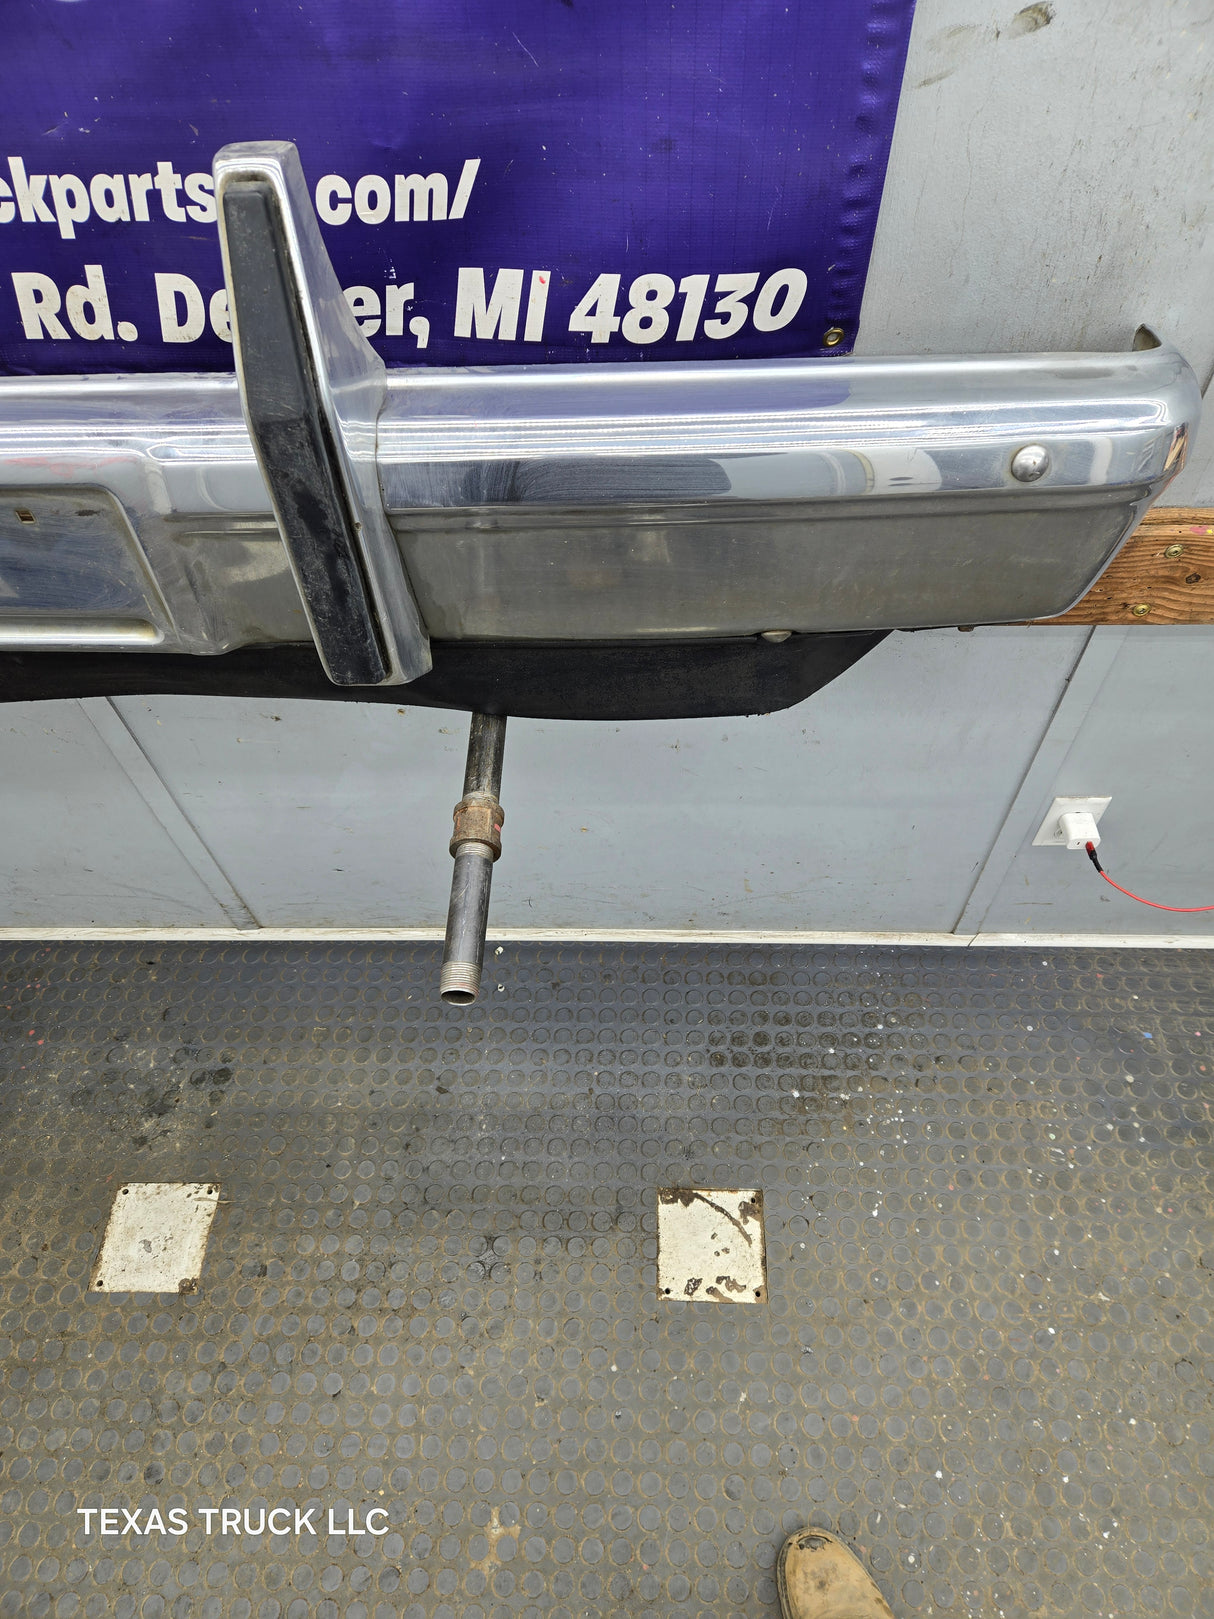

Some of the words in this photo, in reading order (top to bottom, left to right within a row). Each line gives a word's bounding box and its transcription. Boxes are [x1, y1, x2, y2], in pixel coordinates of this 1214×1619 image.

[11, 265, 139, 341] Rd.
[453, 267, 551, 342] MI
[568, 268, 808, 344] 48130
